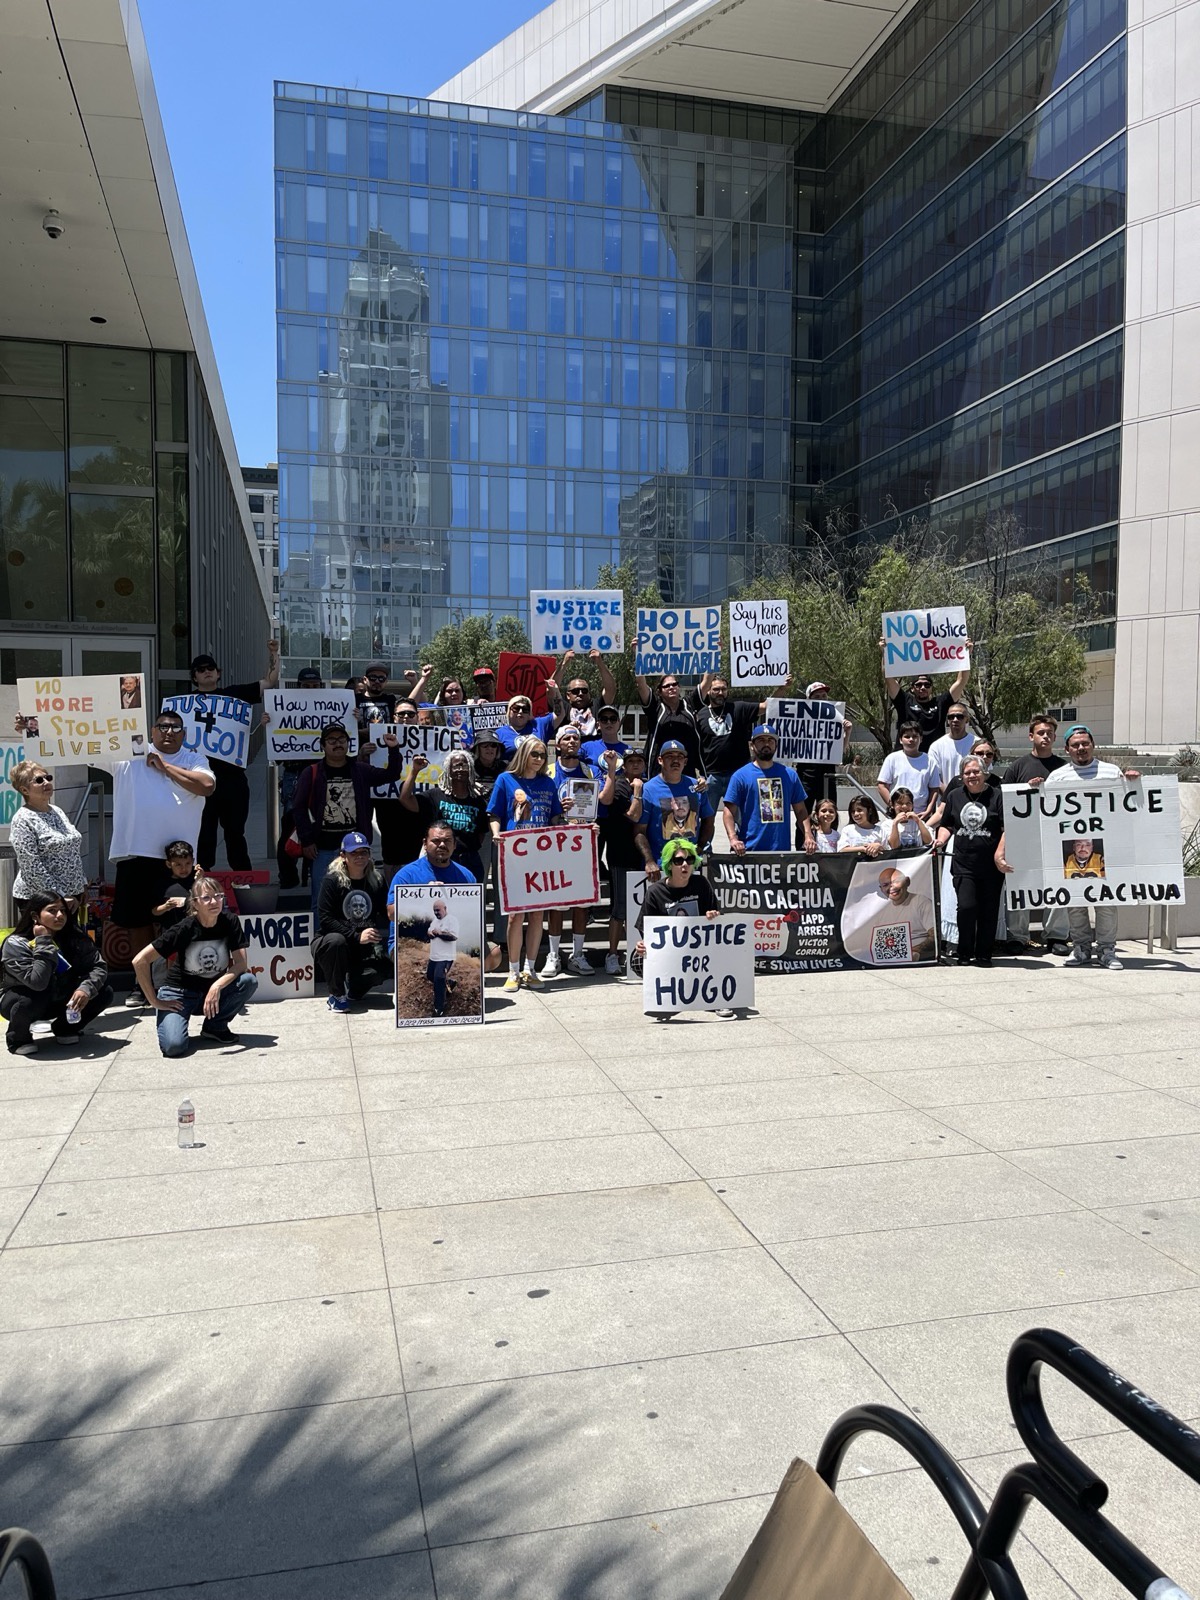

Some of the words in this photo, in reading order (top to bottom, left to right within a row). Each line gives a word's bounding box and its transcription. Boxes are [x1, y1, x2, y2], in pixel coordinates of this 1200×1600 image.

[536, 598, 621, 616] JUSTICE
[733, 603, 757, 629] Say
[761, 602, 782, 620] his
[563, 617, 602, 631] FOR
[639, 608, 719, 631] HOLD
[757, 622, 788, 636] name
[886, 615, 918, 638] NO
[920, 613, 966, 638] Justice
[544, 634, 612, 651] HUGO
[637, 630, 719, 652] POLICE
[733, 636, 772, 658] Hugo
[887, 640, 922, 664] NO
[923, 640, 965, 660] Peace
[635, 651, 721, 675] ACCOUNTABLE
[737, 655, 788, 678] Cachua
[35, 678, 62, 695] NO
[35, 697, 94, 713] MORE
[163, 694, 252, 726] JUSTICE
[274, 695, 307, 711] How
[314, 700, 349, 715] many
[496, 706, 507, 715] FOR
[779, 701, 836, 719] END
[50, 715, 137, 736] STOLEN
[194, 711, 216, 733] 4
[39, 735, 121, 758] LIVES
[181, 727, 246, 766] UGO!
[272, 735, 310, 753] before
[776, 738, 833, 760] IMMUNITY
[1012, 789, 1163, 818] JUSTICE
[1059, 817, 1104, 834] FOR
[512, 832, 583, 857] COPS
[525, 869, 572, 893] KILL
[714, 863, 781, 885] JUSTICE
[786, 862, 819, 884] FOR
[399, 888, 426, 899] Rest
[447, 887, 480, 898] Peace
[715, 889, 760, 910] HUGO
[764, 887, 834, 910] CACHUA
[1011, 887, 1070, 909] HUGO
[1084, 883, 1181, 903] CACHUA
[801, 914, 824, 924] LAPD
[244, 914, 309, 948] MORE
[651, 923, 747, 949] JUSTICE
[797, 924, 835, 937] ARREST
[754, 941, 780, 953] ops!
[795, 948, 830, 956] CORRAL!
[798, 938, 828, 947] VICTOR
[270, 955, 313, 991] Cops
[681, 955, 710, 973] FOR
[770, 959, 809, 971] STOLEN
[810, 958, 843, 970] LIVES
[655, 974, 737, 1005] HUGO
